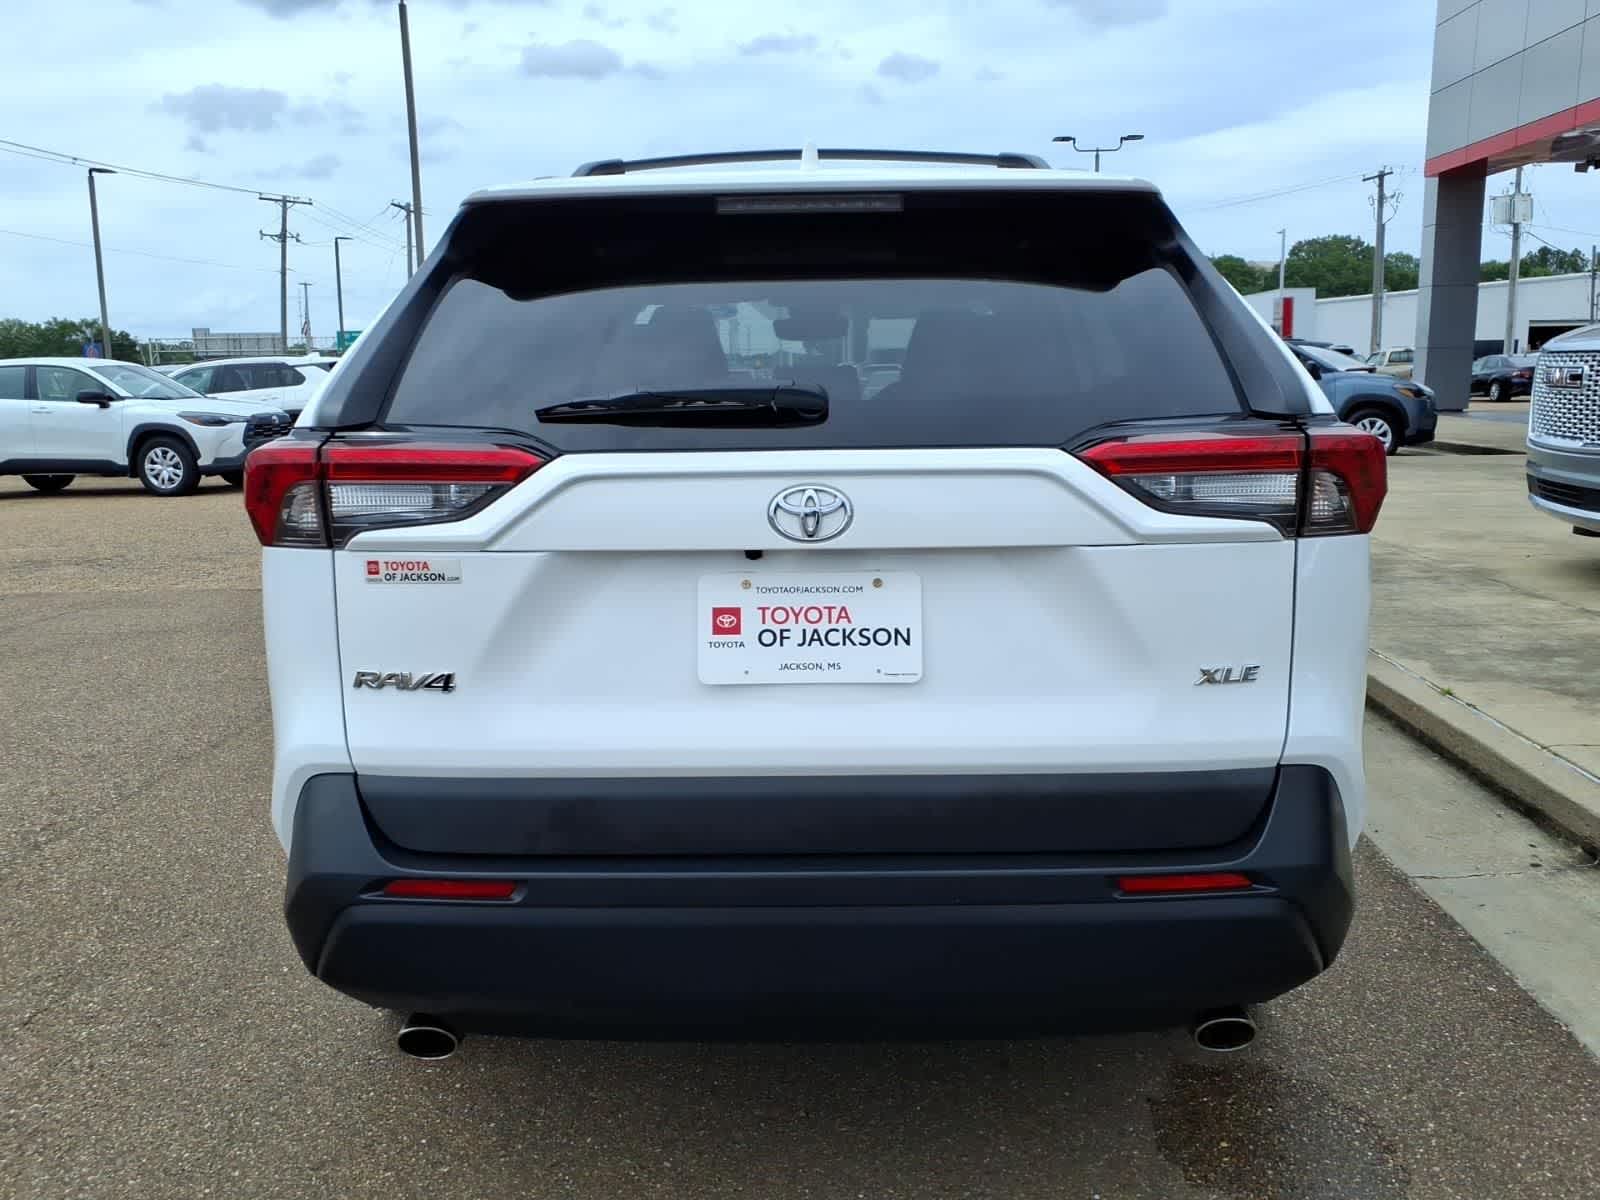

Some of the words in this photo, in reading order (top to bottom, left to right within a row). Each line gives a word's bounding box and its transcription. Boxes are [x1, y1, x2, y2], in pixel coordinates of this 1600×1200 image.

[384, 561, 430, 571] TOYOTA
[385, 573, 397, 581] OF
[756, 586, 864, 594] TOYOTAOFJACKSON.COM
[757, 606, 852, 625] TOYOTA
[758, 628, 791, 647] OF
[797, 628, 911, 647] JACKSON
[779, 662, 825, 671] JACKSON,
[827, 662, 841, 670] MS
[353, 671, 456, 693] RAV4
[1195, 665, 1261, 686] XLE
